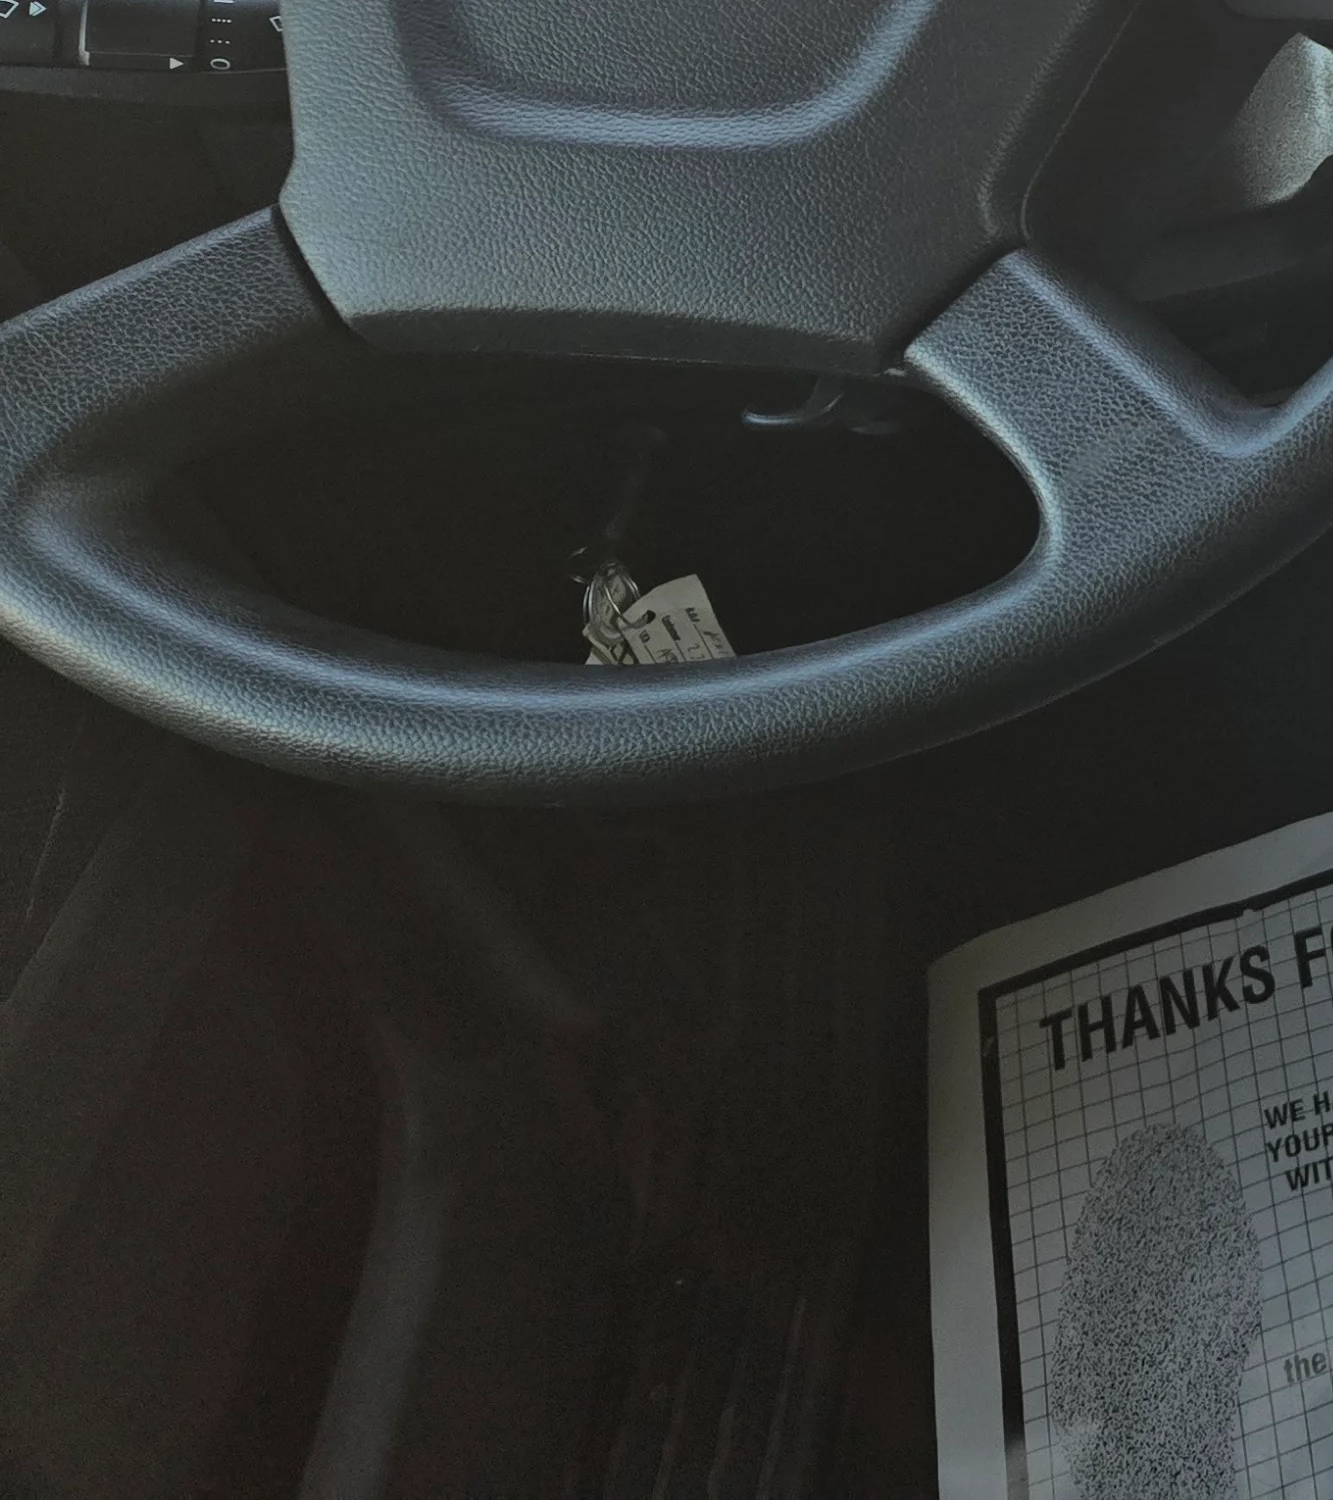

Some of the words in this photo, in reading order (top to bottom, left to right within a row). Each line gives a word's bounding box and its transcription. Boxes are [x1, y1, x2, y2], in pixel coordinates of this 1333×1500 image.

[1039, 945, 1276, 1072] THANKS
[1264, 1099, 1305, 1130] WE
[1284, 1351, 1328, 1386] the
